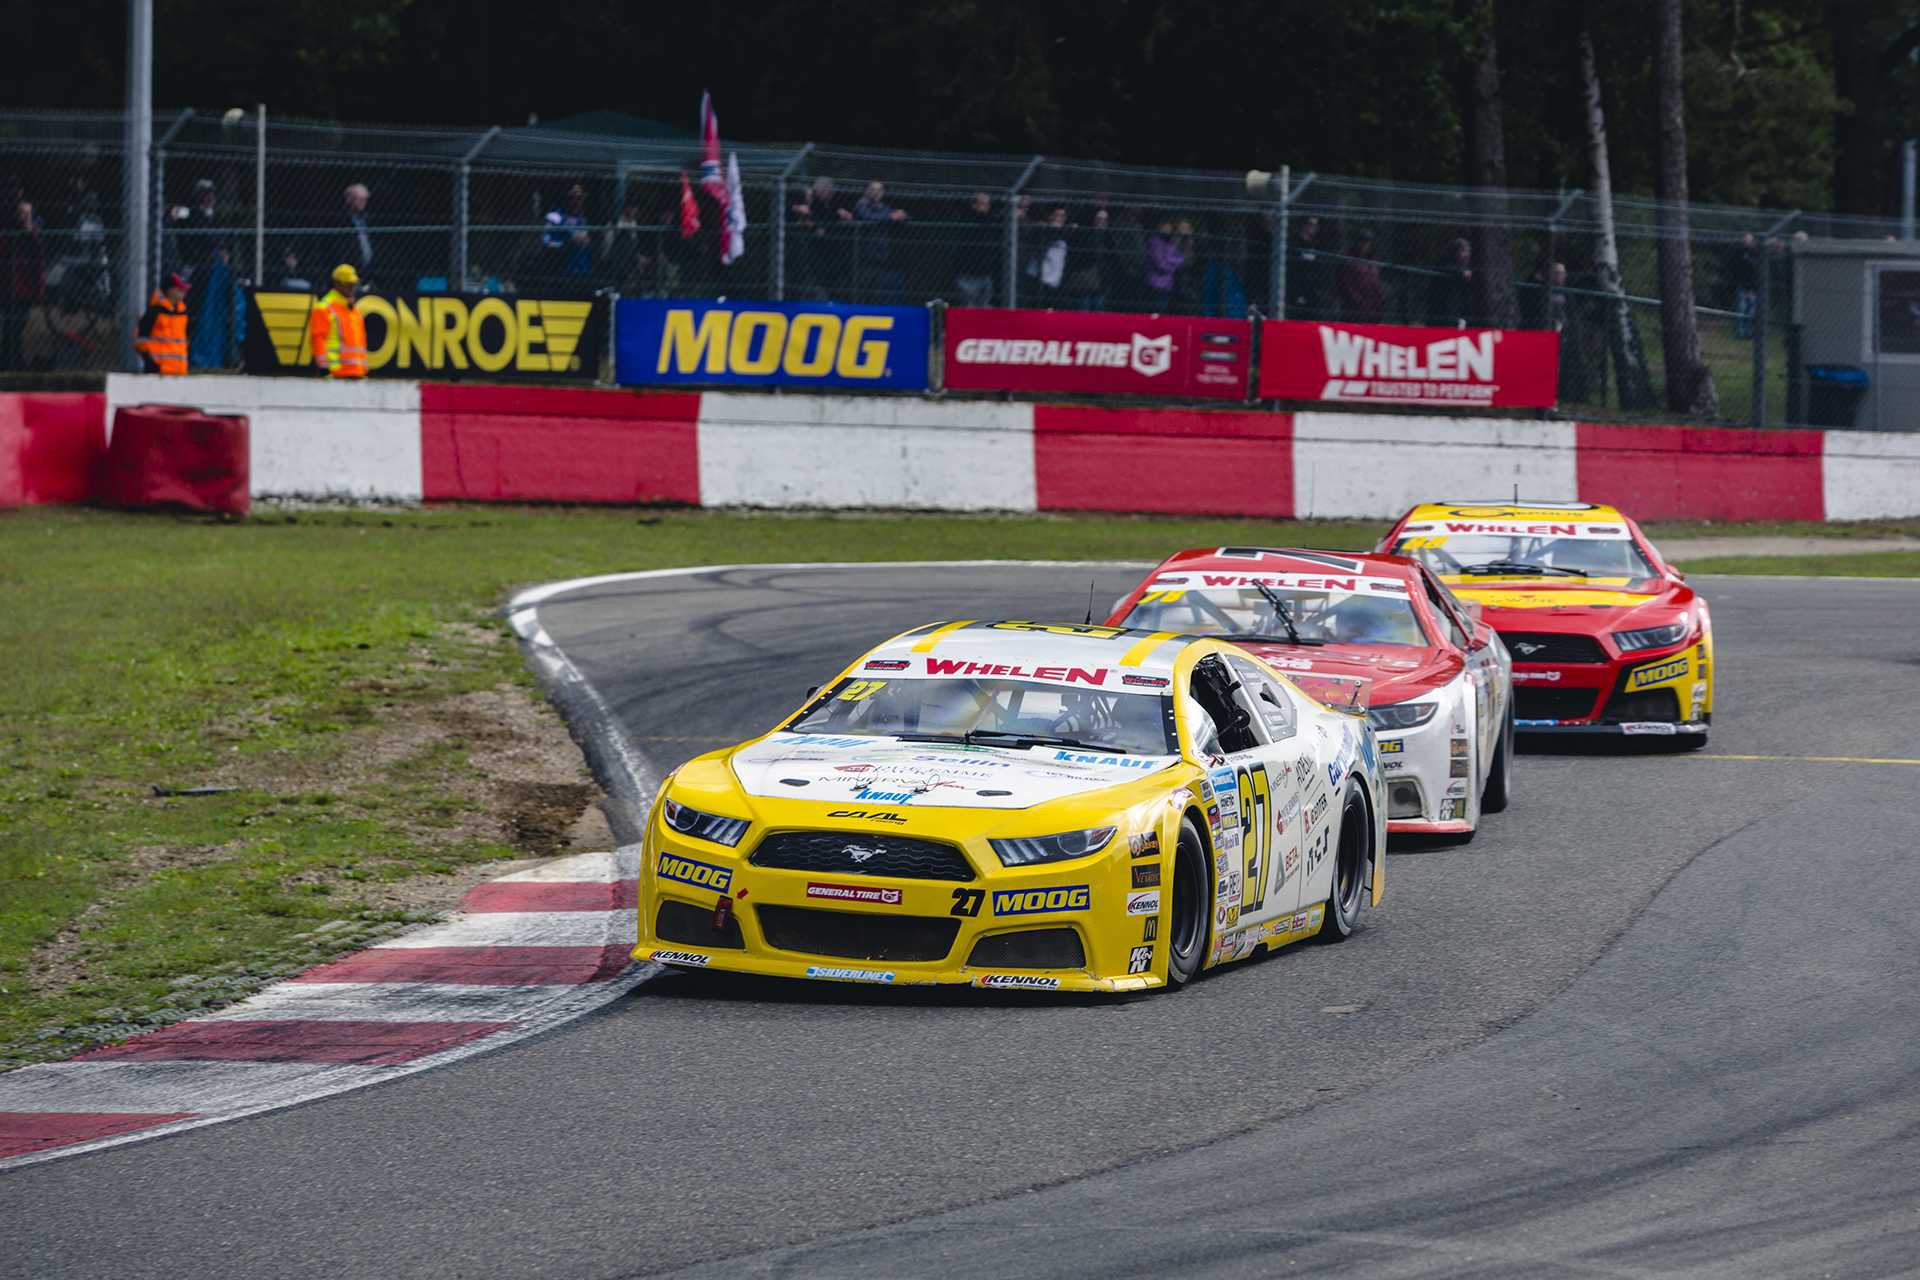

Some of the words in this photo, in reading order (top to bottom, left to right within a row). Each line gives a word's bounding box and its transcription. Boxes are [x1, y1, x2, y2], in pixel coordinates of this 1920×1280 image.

[299, 294, 550, 372] ONROE
[657, 309, 894, 378] MOOG
[955, 338, 1073, 365] GENERAL
[1071, 342, 1130, 368] TIRE
[1319, 325, 1494, 382] WHELEN
[1371, 382, 1421, 396] TRUSTED
[1424, 384, 1438, 397] TO
[1446, 523, 1576, 536] WHELEN
[1202, 575, 1356, 591] WHELEN
[926, 657, 1109, 686] WHELEN
[1637, 659, 1688, 685] MOOG
[837, 680, 888, 701] 27
[1054, 751, 1158, 769] KNAUF
[855, 787, 920, 805] KNAUF
[1237, 761, 1272, 916] 27
[659, 854, 731, 891] MOOG
[808, 886, 855, 898] GENERAL
[854, 892, 881, 900] TIRE
[950, 888, 986, 917] 27
[995, 888, 1088, 913] MOOG
[1132, 899, 1159, 910] KENNOL
[654, 949, 710, 965] KENNOL
[815, 967, 886, 981] SILVERLINE
[987, 975, 1058, 987] KENNOL
